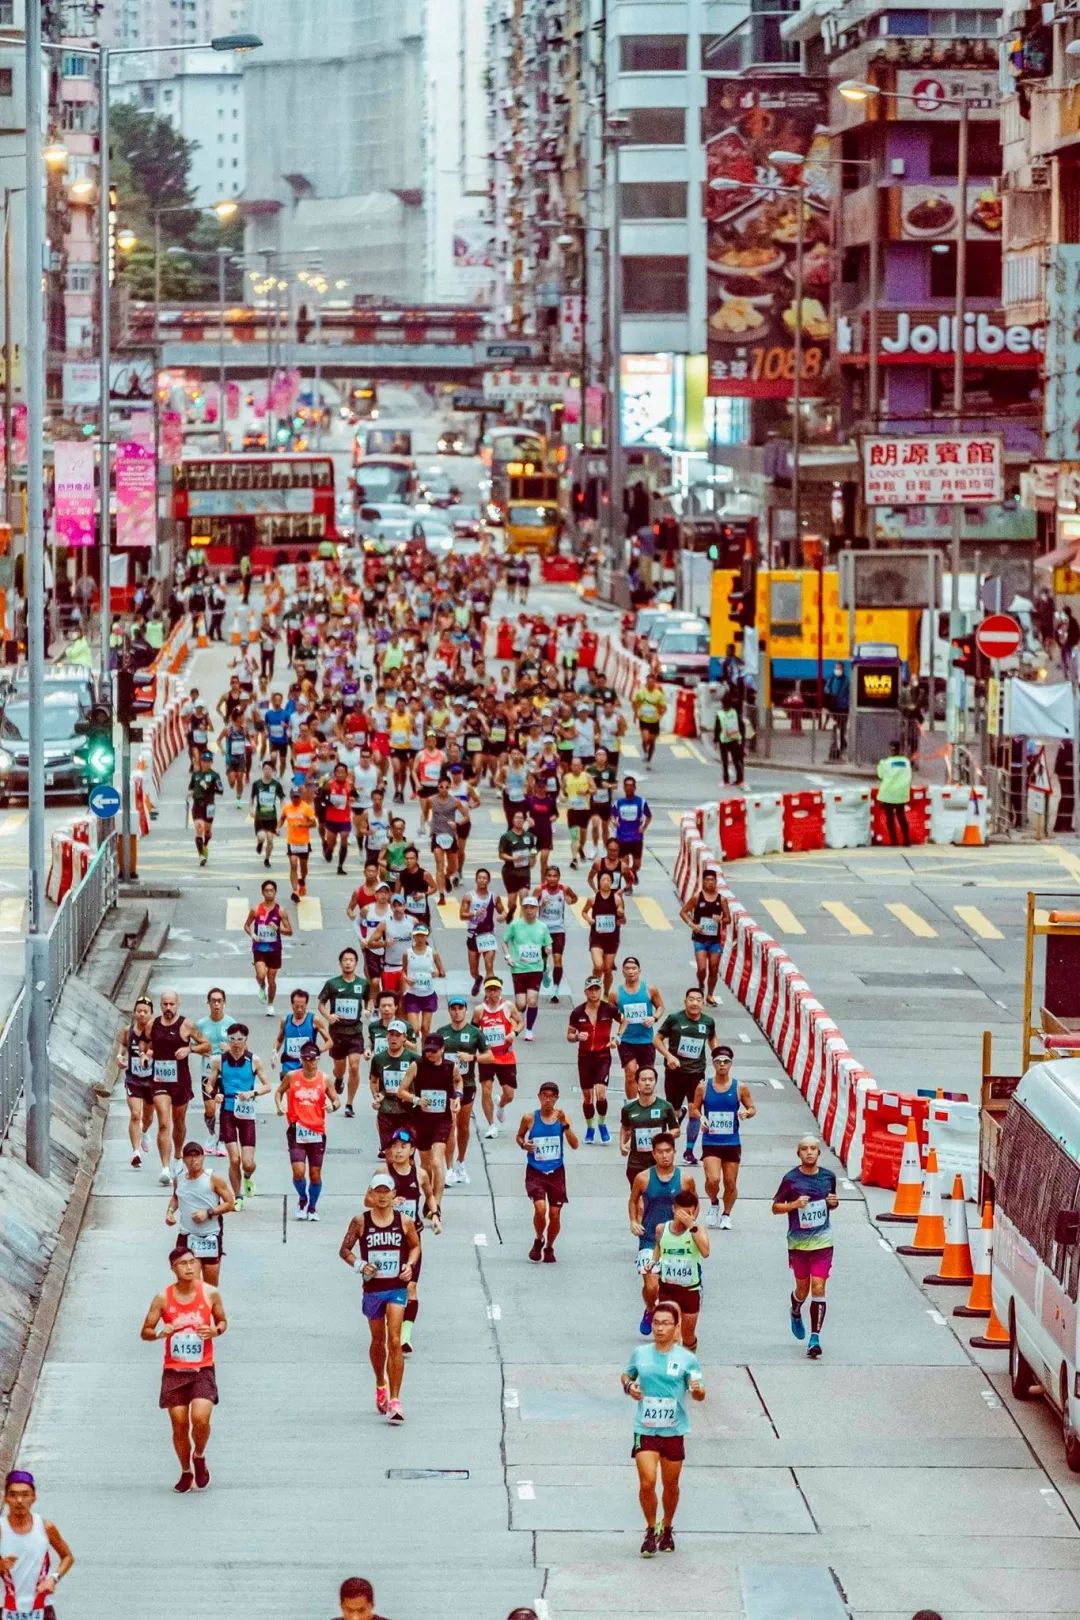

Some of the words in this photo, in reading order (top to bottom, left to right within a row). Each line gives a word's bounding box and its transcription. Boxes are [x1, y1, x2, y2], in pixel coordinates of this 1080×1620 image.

[869, 441, 994, 466] 朗源賓館
[869, 469, 905, 479] LONG
[913, 468, 948, 478] YUEN
[955, 467, 993, 477] HOTEL
[535, 1145, 558, 1155] A1777
[800, 1210, 826, 1222] A2704
[376, 1260, 398, 1271] 2577
[665, 1267, 692, 1278] A1494
[172, 1344, 201, 1354] A1553
[643, 1408, 674, 1420] A2172
